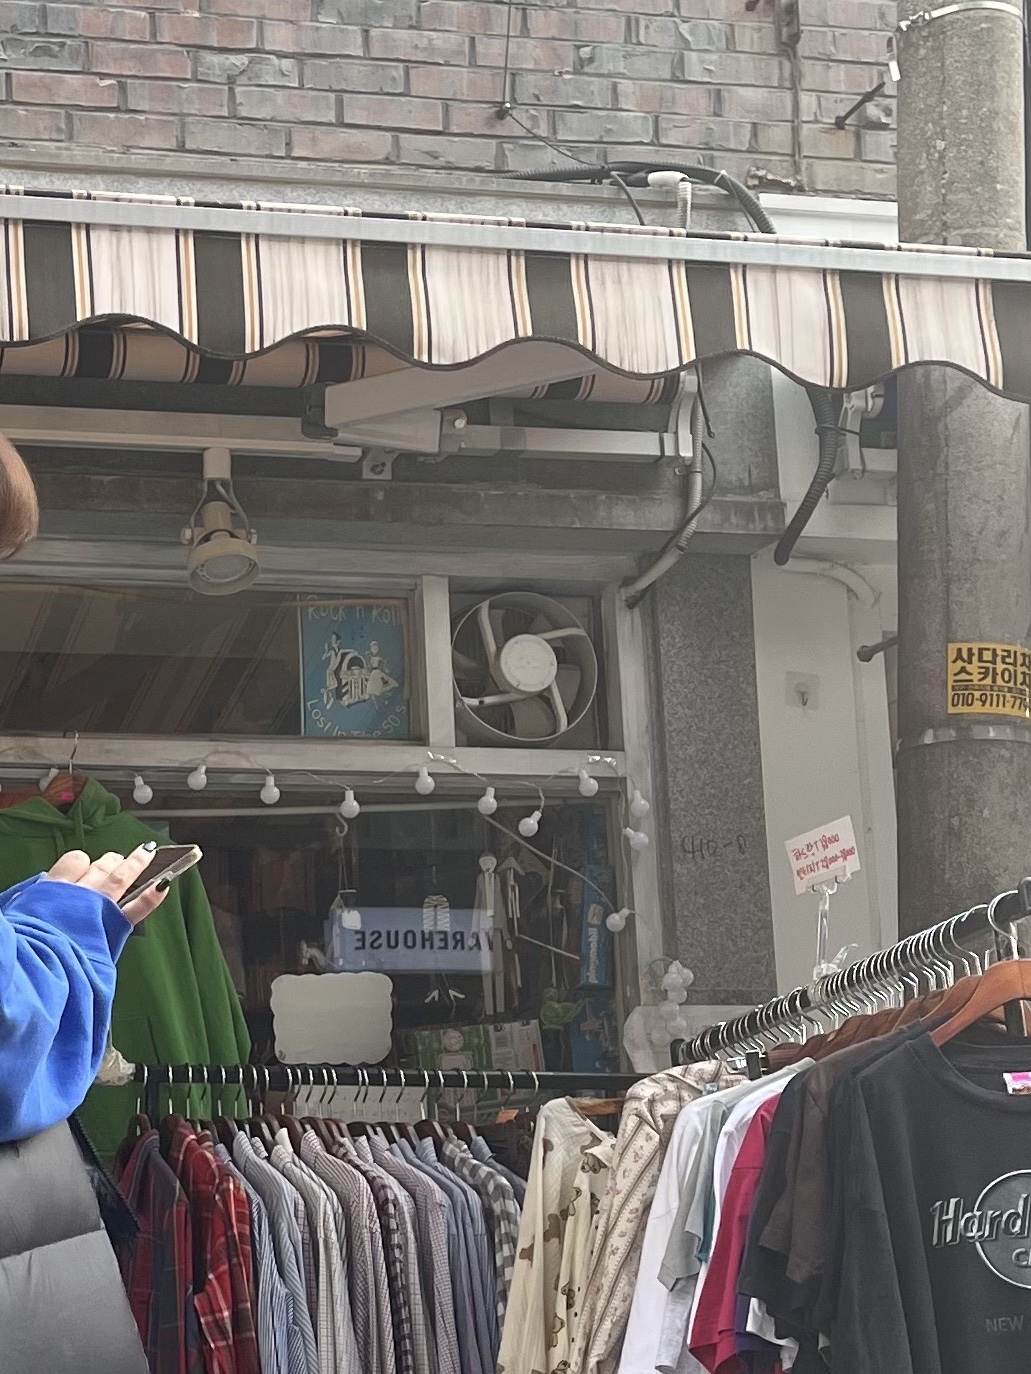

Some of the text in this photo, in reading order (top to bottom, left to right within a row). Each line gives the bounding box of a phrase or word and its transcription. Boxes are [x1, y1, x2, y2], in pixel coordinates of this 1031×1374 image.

[307, 698, 332, 732] Lost
[929, 1194, 1031, 1248] Hard
[1012, 1248, 1031, 1268] C
[985, 1315, 1024, 1333] NEW
